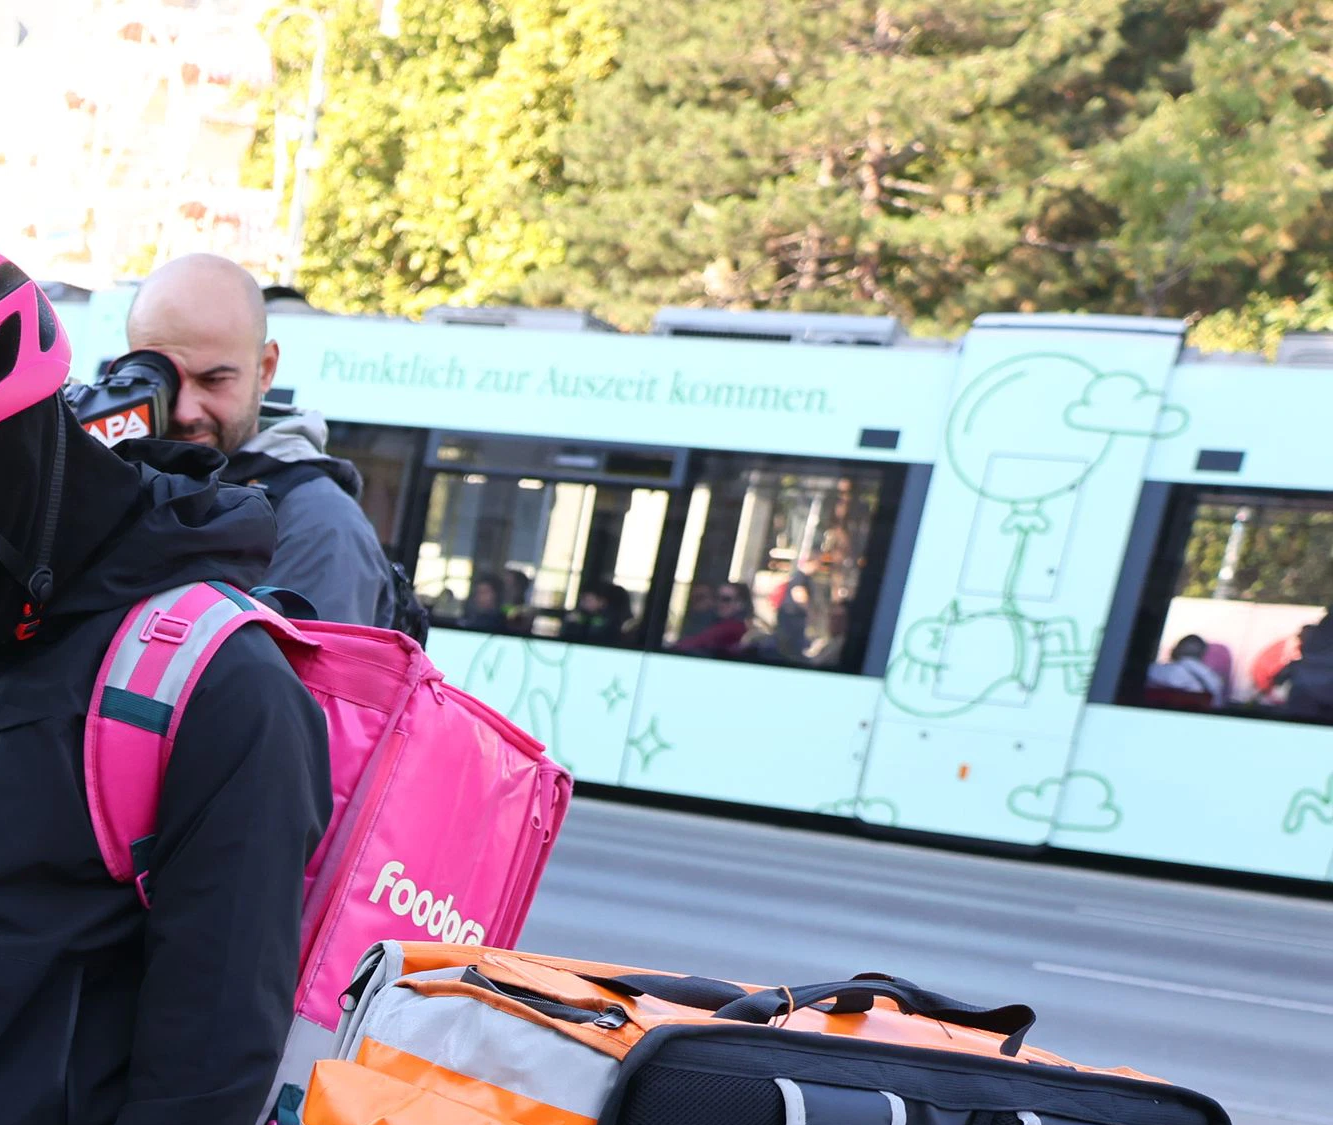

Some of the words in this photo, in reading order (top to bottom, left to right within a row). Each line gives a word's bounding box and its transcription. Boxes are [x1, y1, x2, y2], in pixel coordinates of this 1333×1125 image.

[319, 347, 466, 391] Pünktlich
[475, 370, 529, 393] zur
[536, 364, 659, 403] Auszeit
[667, 369, 836, 416] kommen.
[367, 860, 485, 945] foodora
